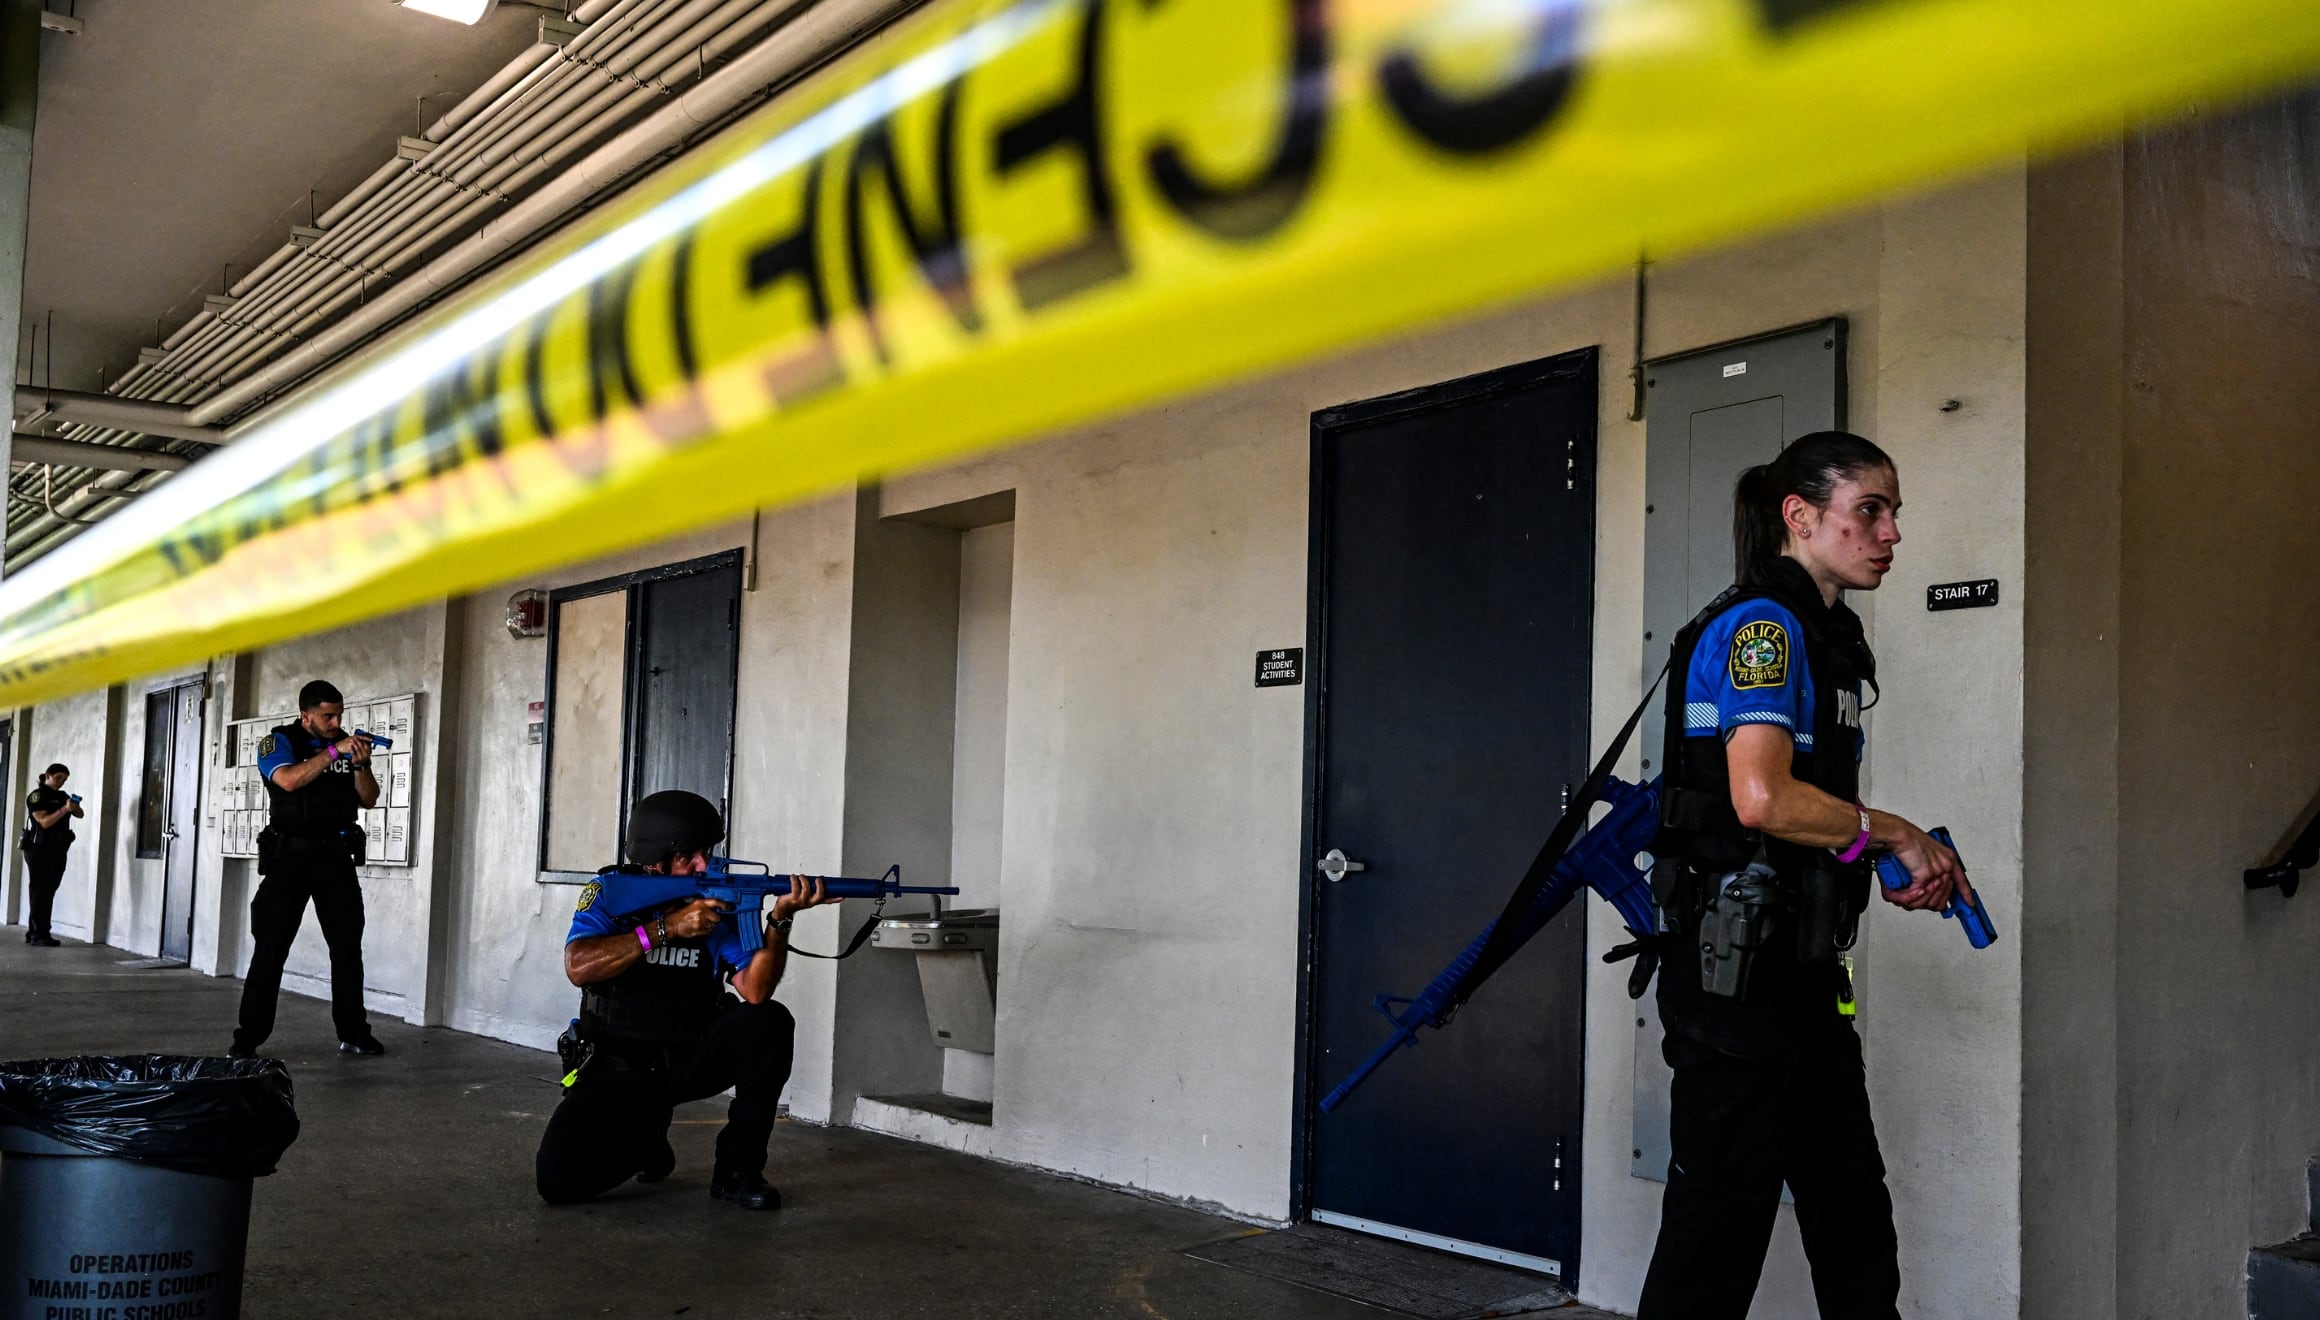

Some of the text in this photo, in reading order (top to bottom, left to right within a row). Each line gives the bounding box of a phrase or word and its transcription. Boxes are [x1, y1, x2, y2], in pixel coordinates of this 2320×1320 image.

[1935, 584, 1989, 600] STAIR 17
[1735, 624, 1783, 647] POLICE
[1261, 670, 1295, 680] ACTIVITIES
[1263, 660, 1294, 670] STUDENT
[1738, 670, 1781, 681] FLORIDA
[1837, 688, 1858, 727] POLI
[645, 946, 701, 968] OLICE
[69, 1250, 193, 1274] OPERATIONS
[28, 1270, 225, 1300] MIAMI-DADE COUNTY
[46, 1298, 205, 1320] PUBLIC SCHOOLS
